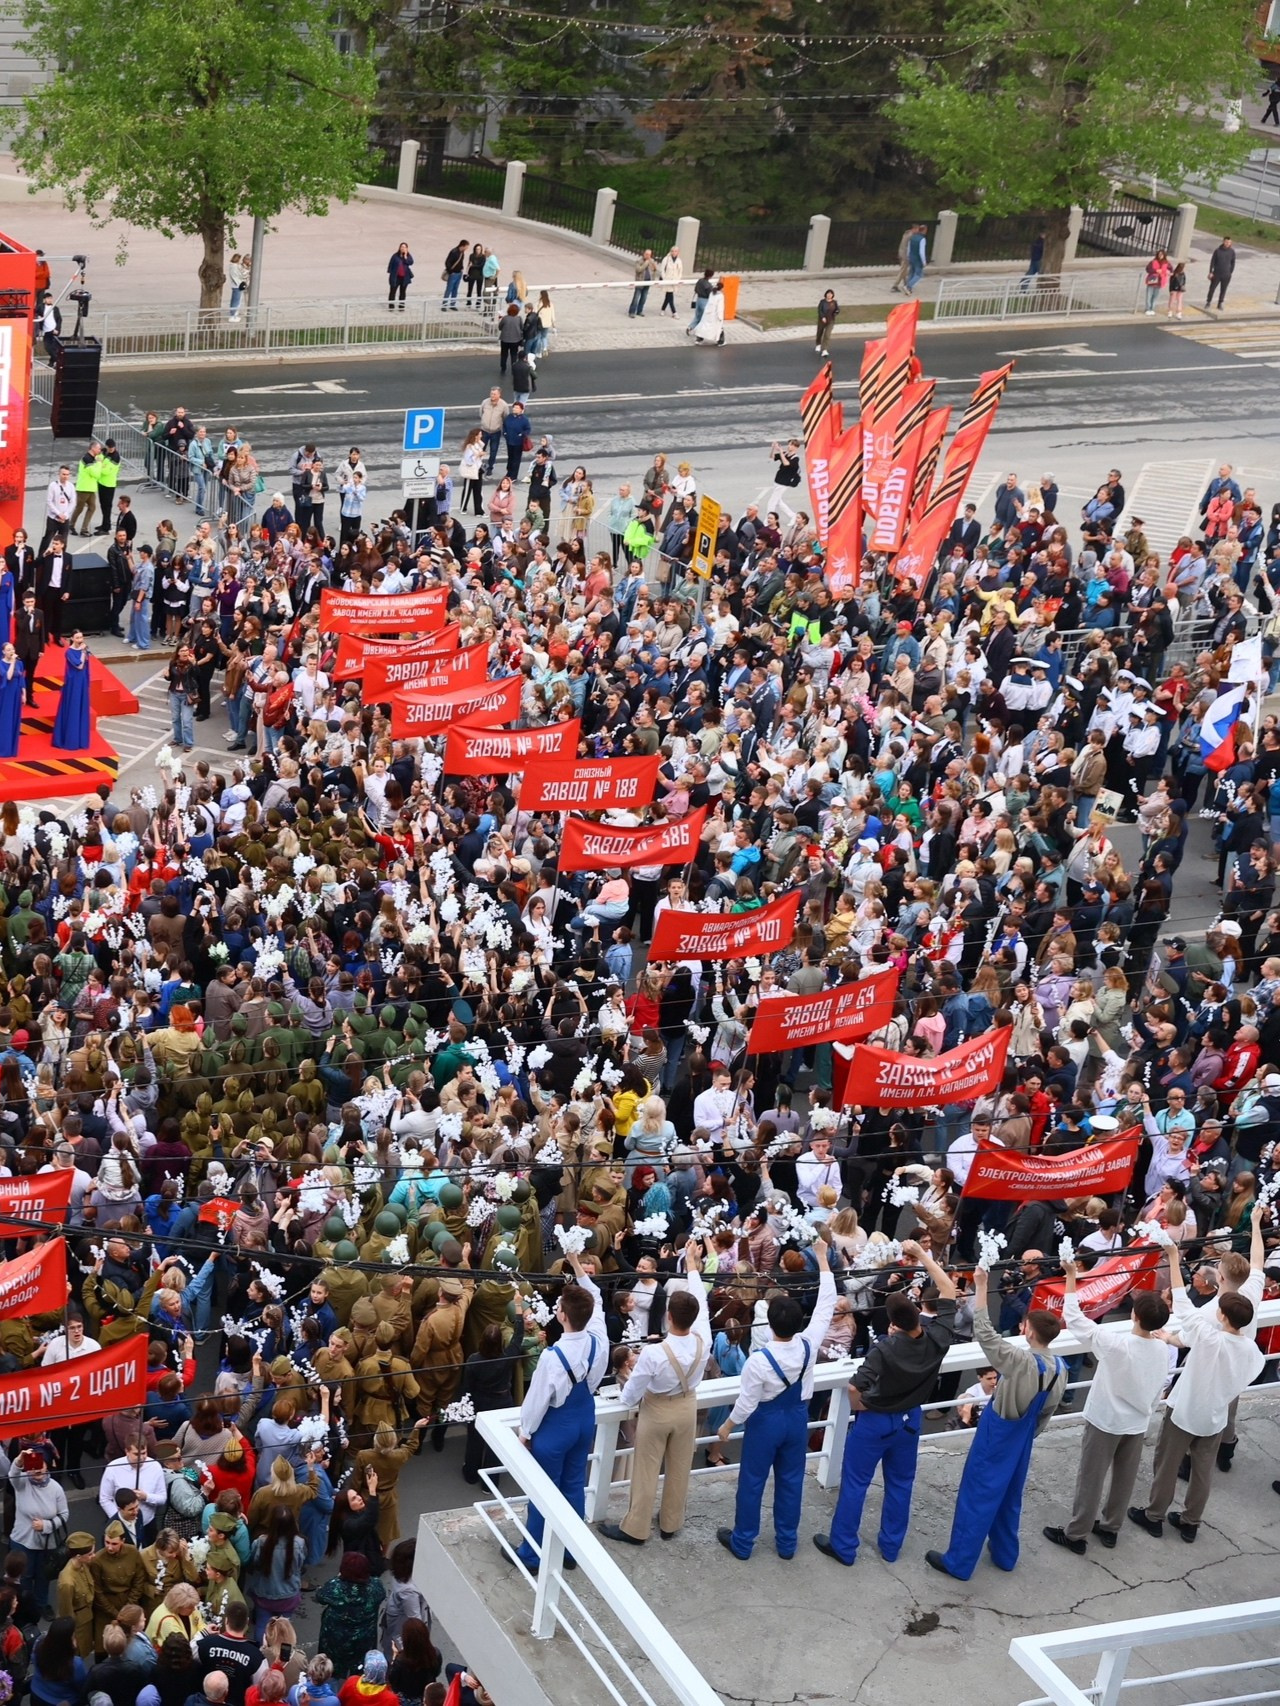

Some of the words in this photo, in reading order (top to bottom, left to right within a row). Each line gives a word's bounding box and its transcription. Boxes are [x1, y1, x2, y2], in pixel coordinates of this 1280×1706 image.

[413, 414, 435, 445] P
[391, 595, 443, 606] АВИАЦИОННЫЙ
[332, 609, 357, 618] ЗАВОД
[358, 609, 382, 618] ИМЕНИ
[385, 661, 429, 682] ЗАВОД
[404, 678, 428, 690] ИМЕНИ
[406, 703, 454, 723] ЗАВОД
[457, 692, 507, 715] «ТРУД»
[465, 738, 511, 758] ЗАВОД
[517, 738, 532, 754] №
[538, 733, 562, 754] 702
[573, 765, 612, 779] СОЮЗНЫЙ
[540, 781, 588, 802] ЗАВОД
[593, 780, 610, 799] №
[615, 778, 638, 799] 188
[582, 833, 635, 856] ЗАВОД
[701, 911, 768, 933] АВИАРЕМОНТНЫЙ
[676, 933, 728, 953] ЗАВОД
[734, 926, 751, 947] №
[757, 919, 781, 942] 401
[781, 999, 833, 1028] ЗАВОД
[835, 994, 852, 1015] №
[856, 985, 875, 1010] 69
[786, 1025, 816, 1040] ИМЕНИ
[816, 1023, 831, 1034] В.И.
[833, 1012, 864, 1029] ЛЕНИНА
[875, 1062, 938, 1087] ЗАВОД
[879, 1087, 915, 1098] ИМЕНИ
[916, 1087, 936, 1098] Л.М.
[938, 1070, 989, 1095] КАГАНОВИЧА
[977, 1163, 1106, 1182] ЭЛЕКТРОВОЗОРЕМОНТНЫЙ
[1105, 1154, 1132, 1173] ЗАВОД
[1021, 1147, 1104, 1170] НОВОСИБИРСКИЙ
[9, 1199, 45, 1223] 208
[40, 1381, 62, 1408] №
[70, 1375, 80, 1401] 2
[89, 1360, 136, 1396] ЦАГИ
[209, 1647, 250, 1666] STRONG
